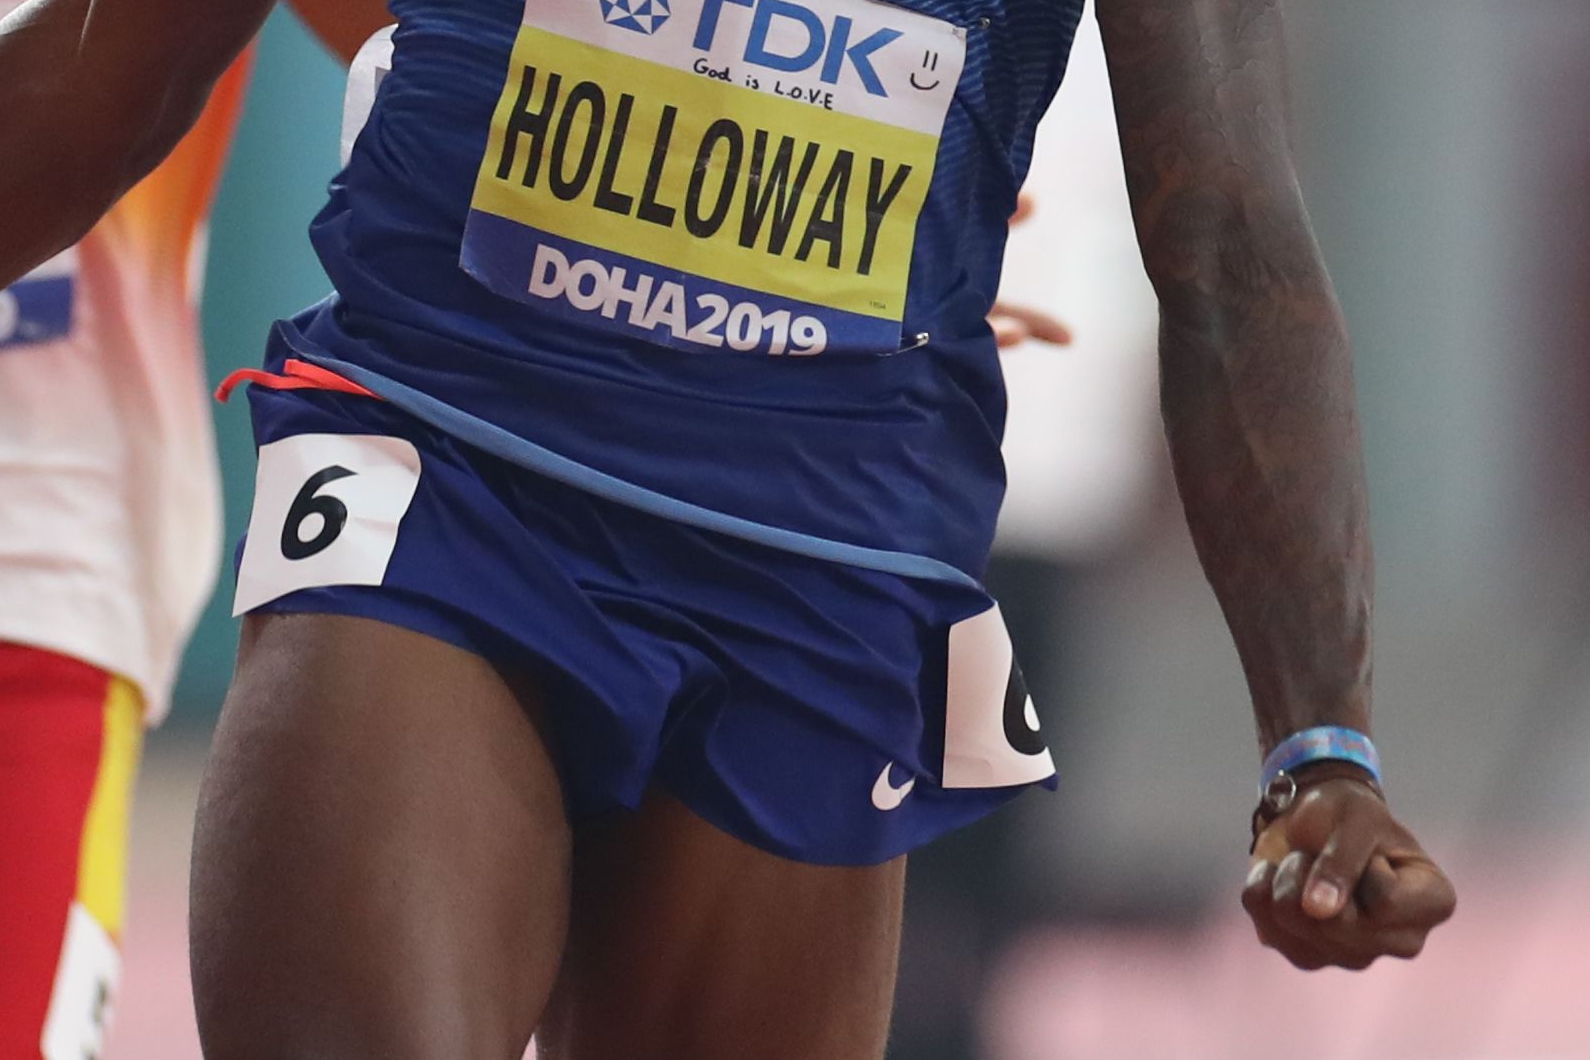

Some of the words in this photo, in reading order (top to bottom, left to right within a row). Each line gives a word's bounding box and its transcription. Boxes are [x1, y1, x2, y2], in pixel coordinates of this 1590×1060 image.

[693, 57, 732, 82] God
[745, 74, 760, 90] is
[495, 65, 913, 276] HOLLOWAY
[527, 243, 828, 356] DOHA2019
[281, 464, 359, 561] 6
